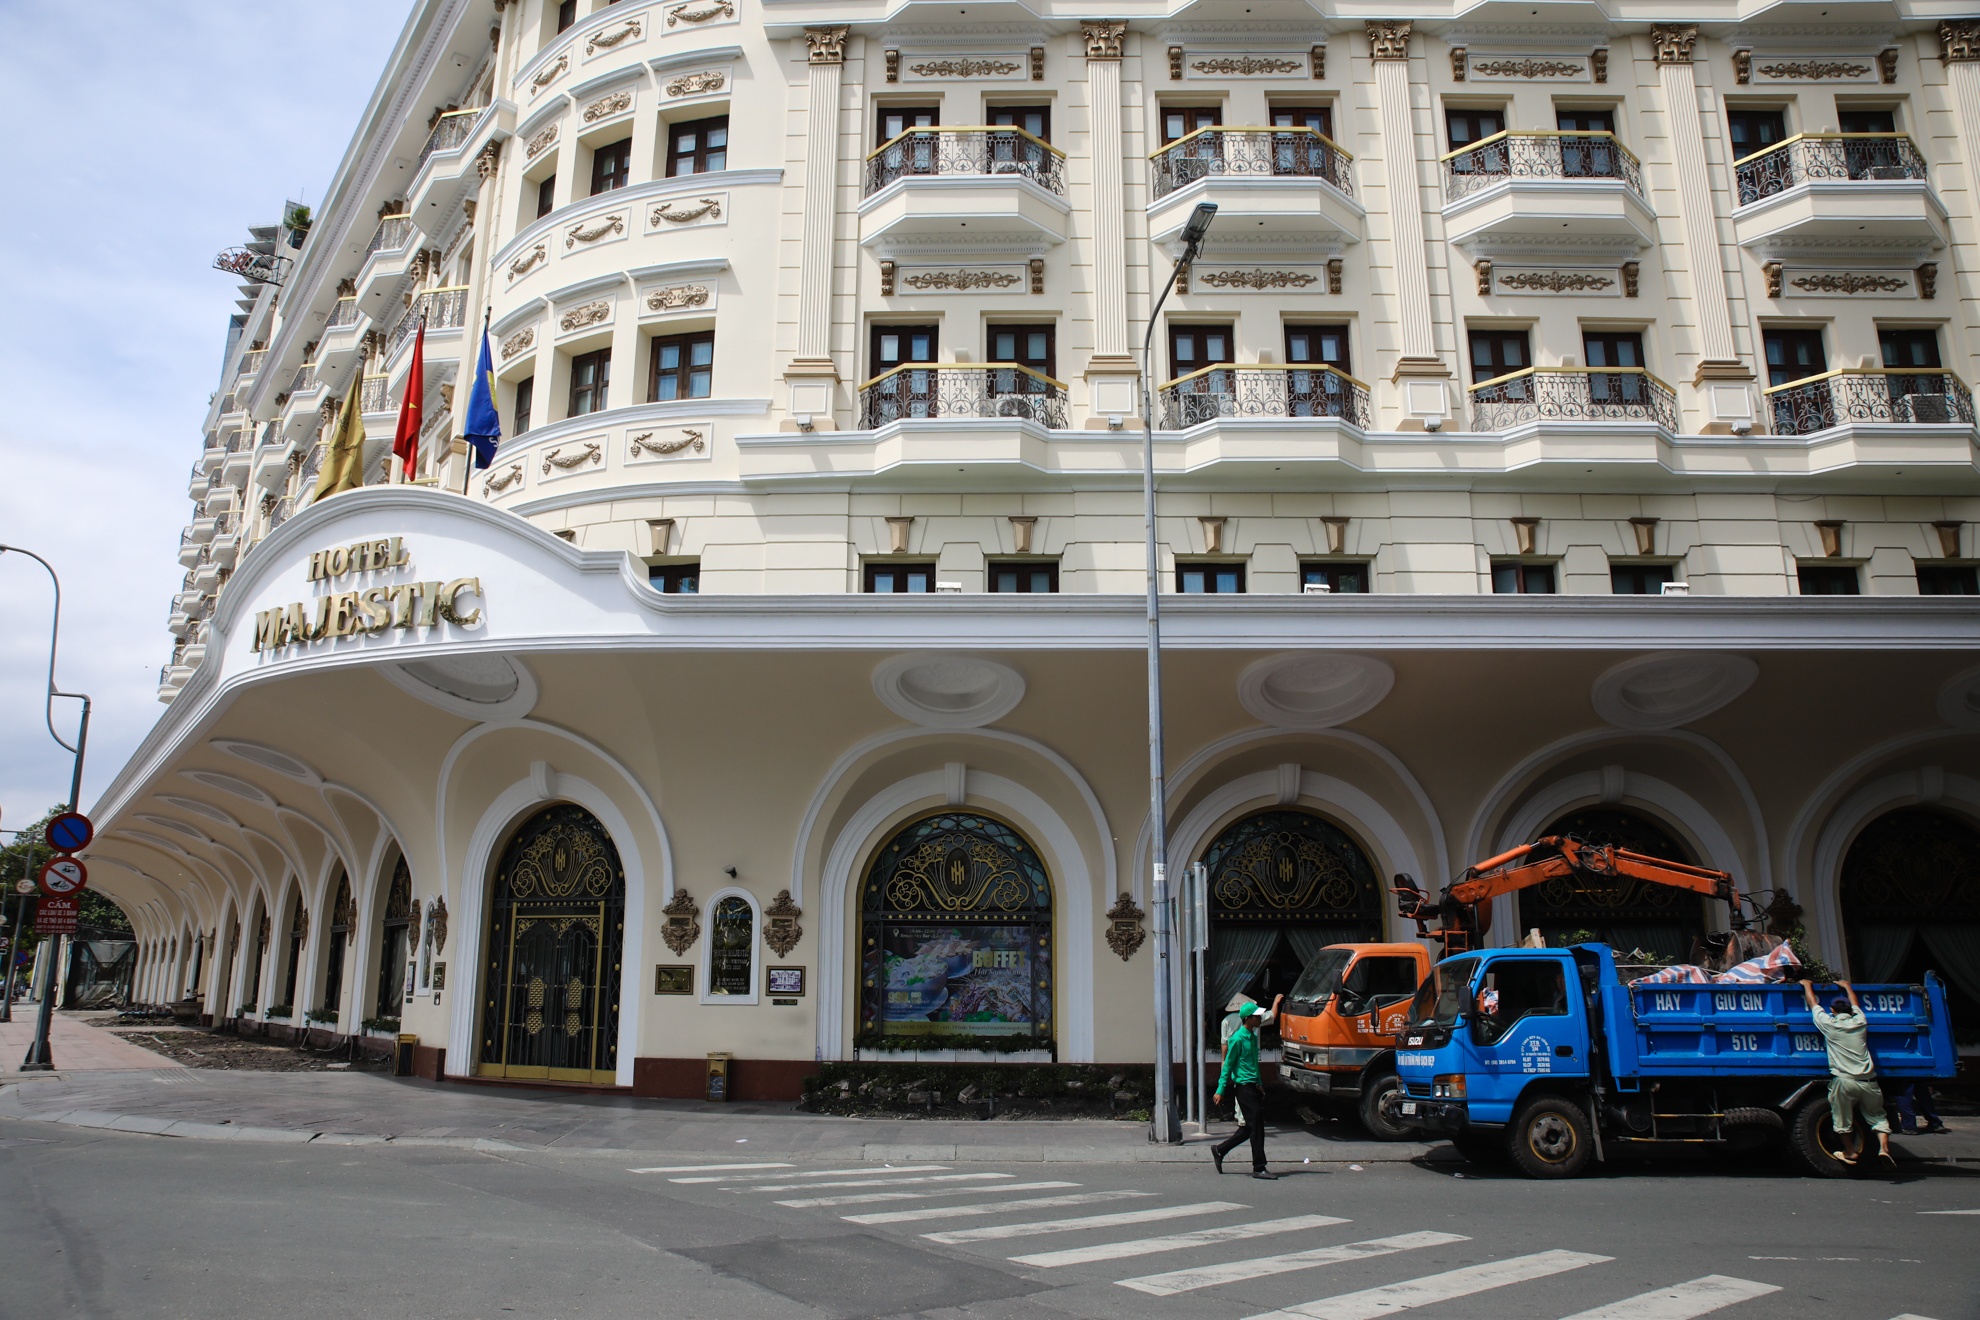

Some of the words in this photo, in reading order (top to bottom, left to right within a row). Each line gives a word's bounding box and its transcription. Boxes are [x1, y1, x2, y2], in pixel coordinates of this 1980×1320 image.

[306, 536, 411, 582] HOTEL
[250, 577, 481, 653] MAJESTIC
[47, 899, 72, 908] CẤM
[972, 950, 1027, 968] BUFFET
[1655, 991, 1681, 1011] HÃY
[1715, 990, 1737, 1011] GIỮ
[1740, 990, 1763, 1011] GÌN
[1878, 995, 1904, 1014] ĐẸP
[1407, 1036, 1423, 1046] ISUZU
[1731, 1034, 1758, 1051] 51C
[1794, 1034, 1825, 1051] 083.
